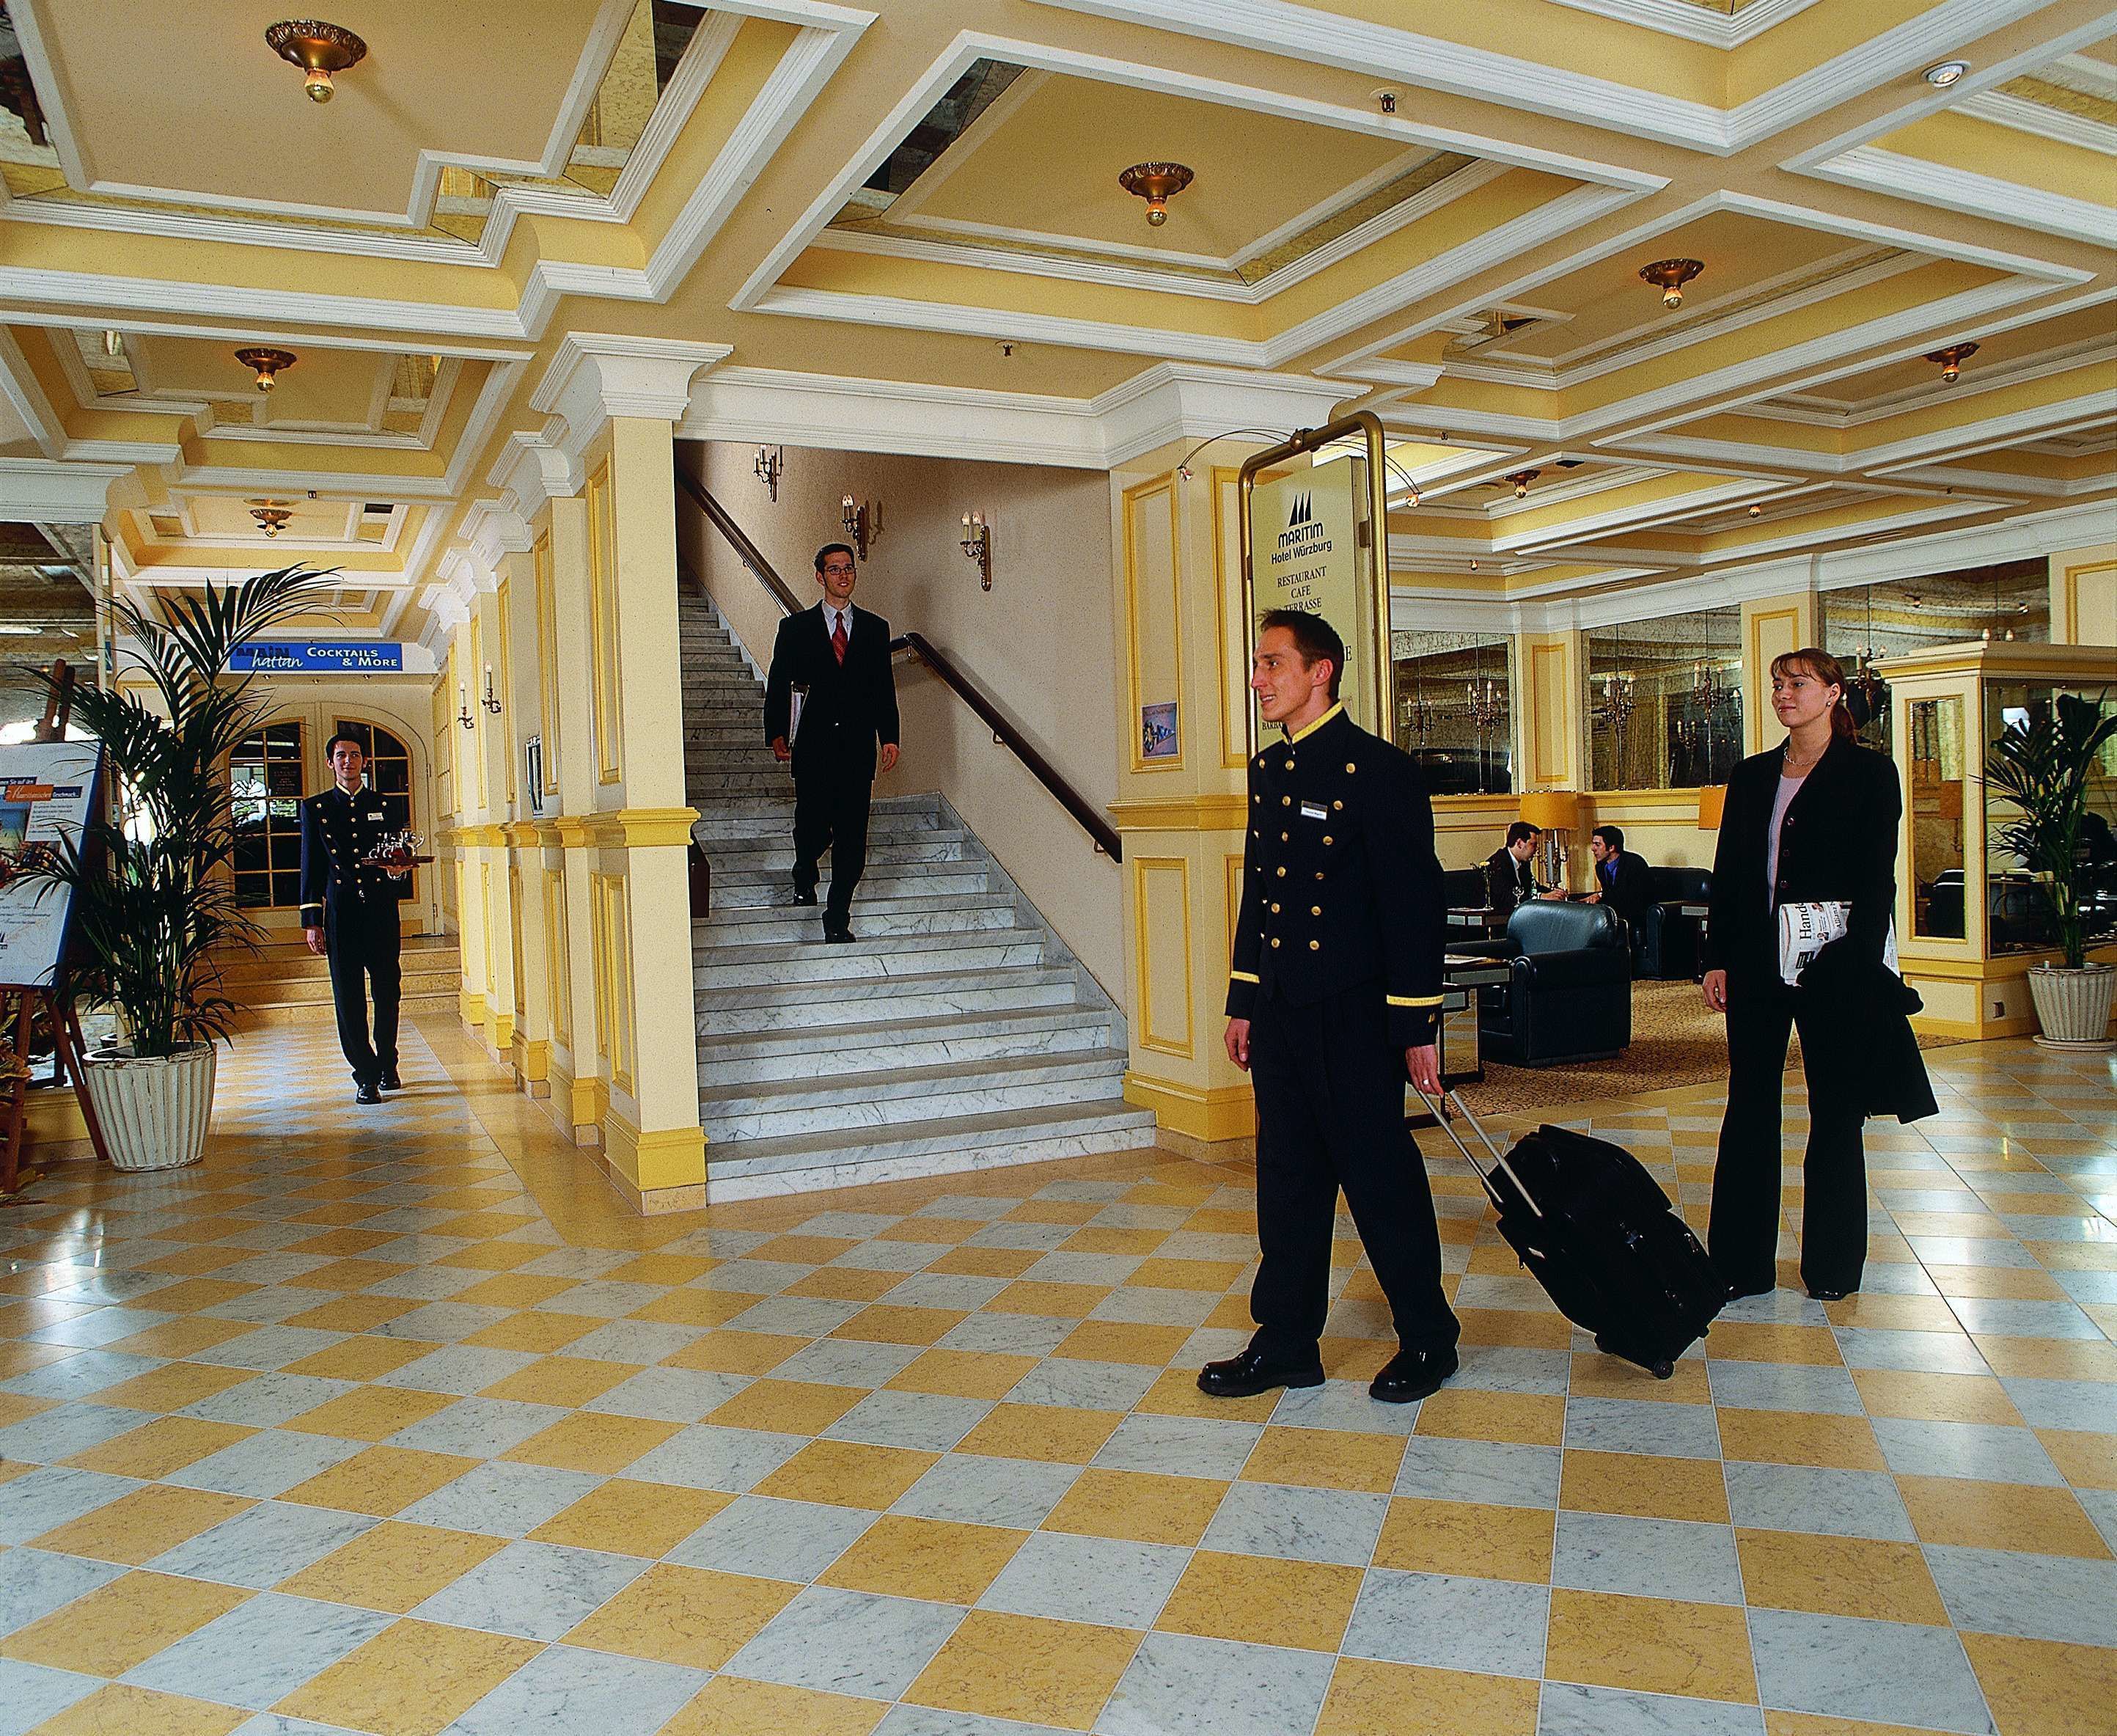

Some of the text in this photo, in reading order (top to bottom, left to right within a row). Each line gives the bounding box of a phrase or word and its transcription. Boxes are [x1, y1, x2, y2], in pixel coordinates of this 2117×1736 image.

[1278, 522, 1324, 549] MARITIM
[1271, 540, 1332, 565] Hotel Würzburg
[1277, 565, 1327, 587] RESTAURANT
[1291, 585, 1312, 598] CAFE
[1284, 597, 1322, 612] TERRASSE
[252, 649, 303, 668] hattan
[342, 657, 353, 667] &
